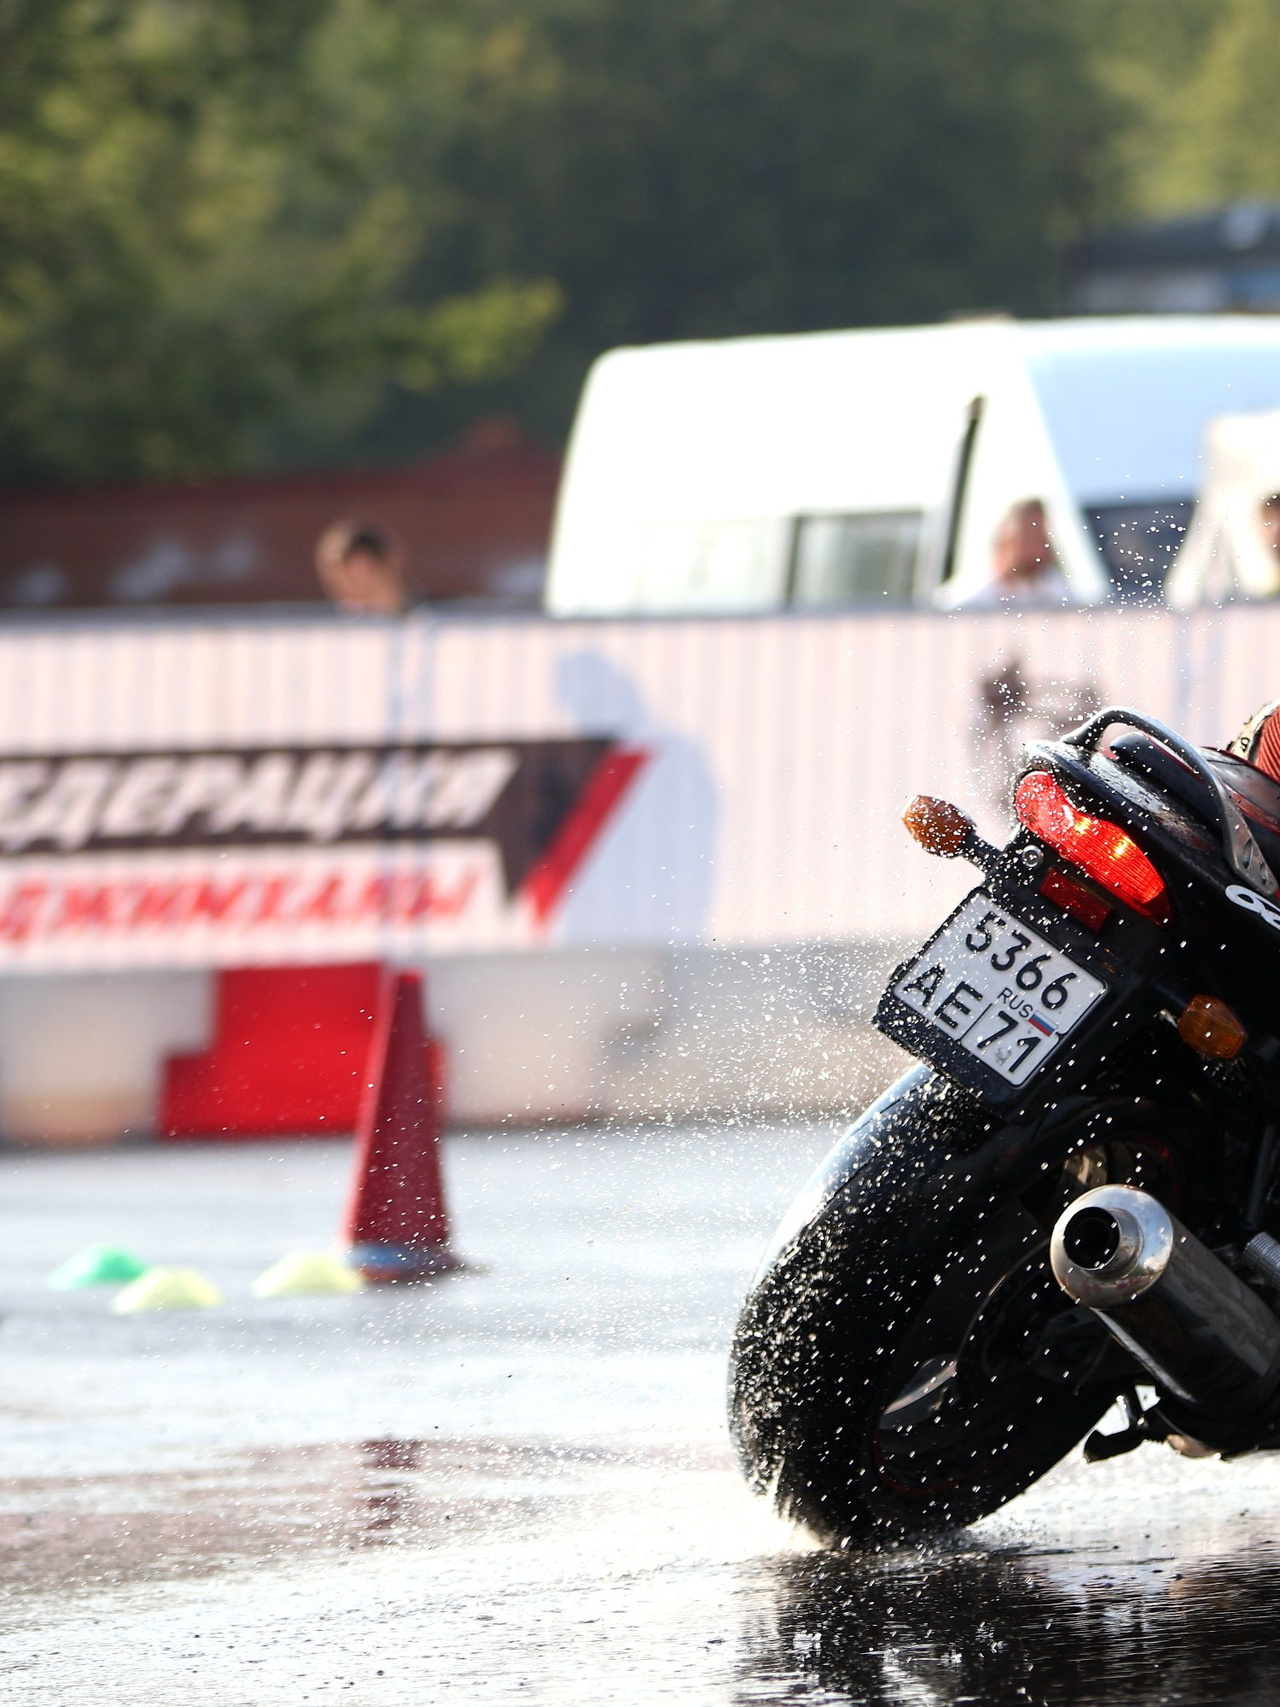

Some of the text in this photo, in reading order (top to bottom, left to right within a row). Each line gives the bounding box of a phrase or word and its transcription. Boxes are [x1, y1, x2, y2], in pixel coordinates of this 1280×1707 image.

[965, 910, 1078, 1010] 5366
[997, 986, 1034, 1018] RUS
[976, 1010, 1042, 1073] 71
